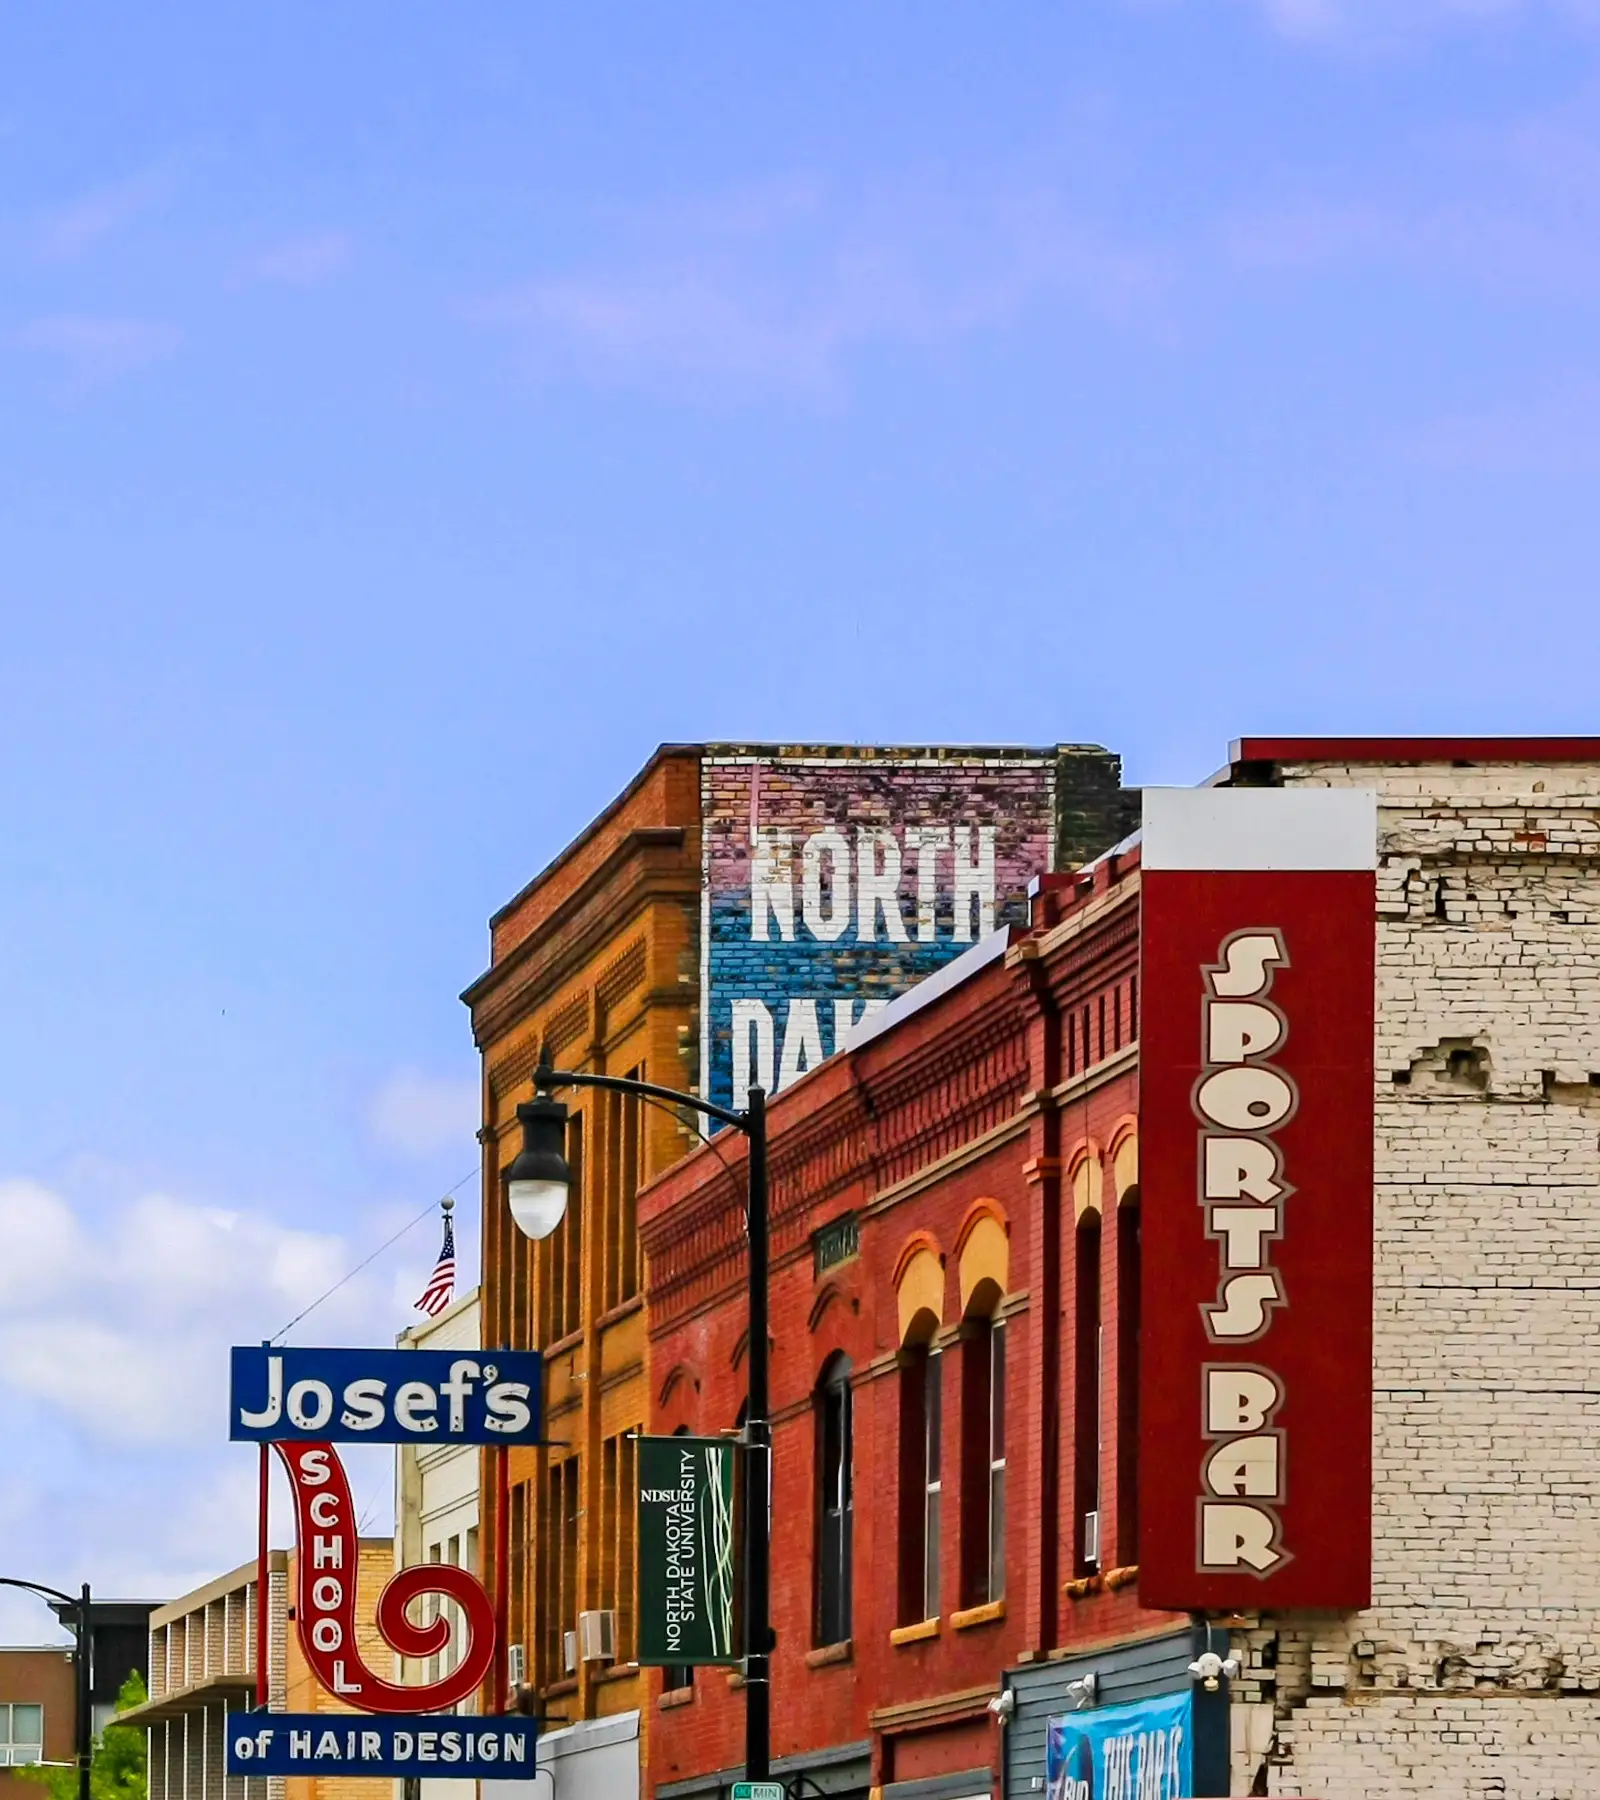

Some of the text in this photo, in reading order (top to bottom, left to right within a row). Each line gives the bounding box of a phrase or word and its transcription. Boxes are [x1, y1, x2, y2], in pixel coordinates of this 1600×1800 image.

[751, 826, 996, 942] NORTH
[1192, 928, 1298, 1577] SPORTS BAR
[240, 1356, 531, 1433] Josef's
[641, 1489, 682, 1502] NDSU
[681, 1449, 695, 1621] STATE UNIVERSITY
[299, 1450, 362, 1693] SCHOOL
[666, 1503, 681, 1651] NORTH DAKOTA
[234, 1729, 526, 1763] of HAIR DESIGN
